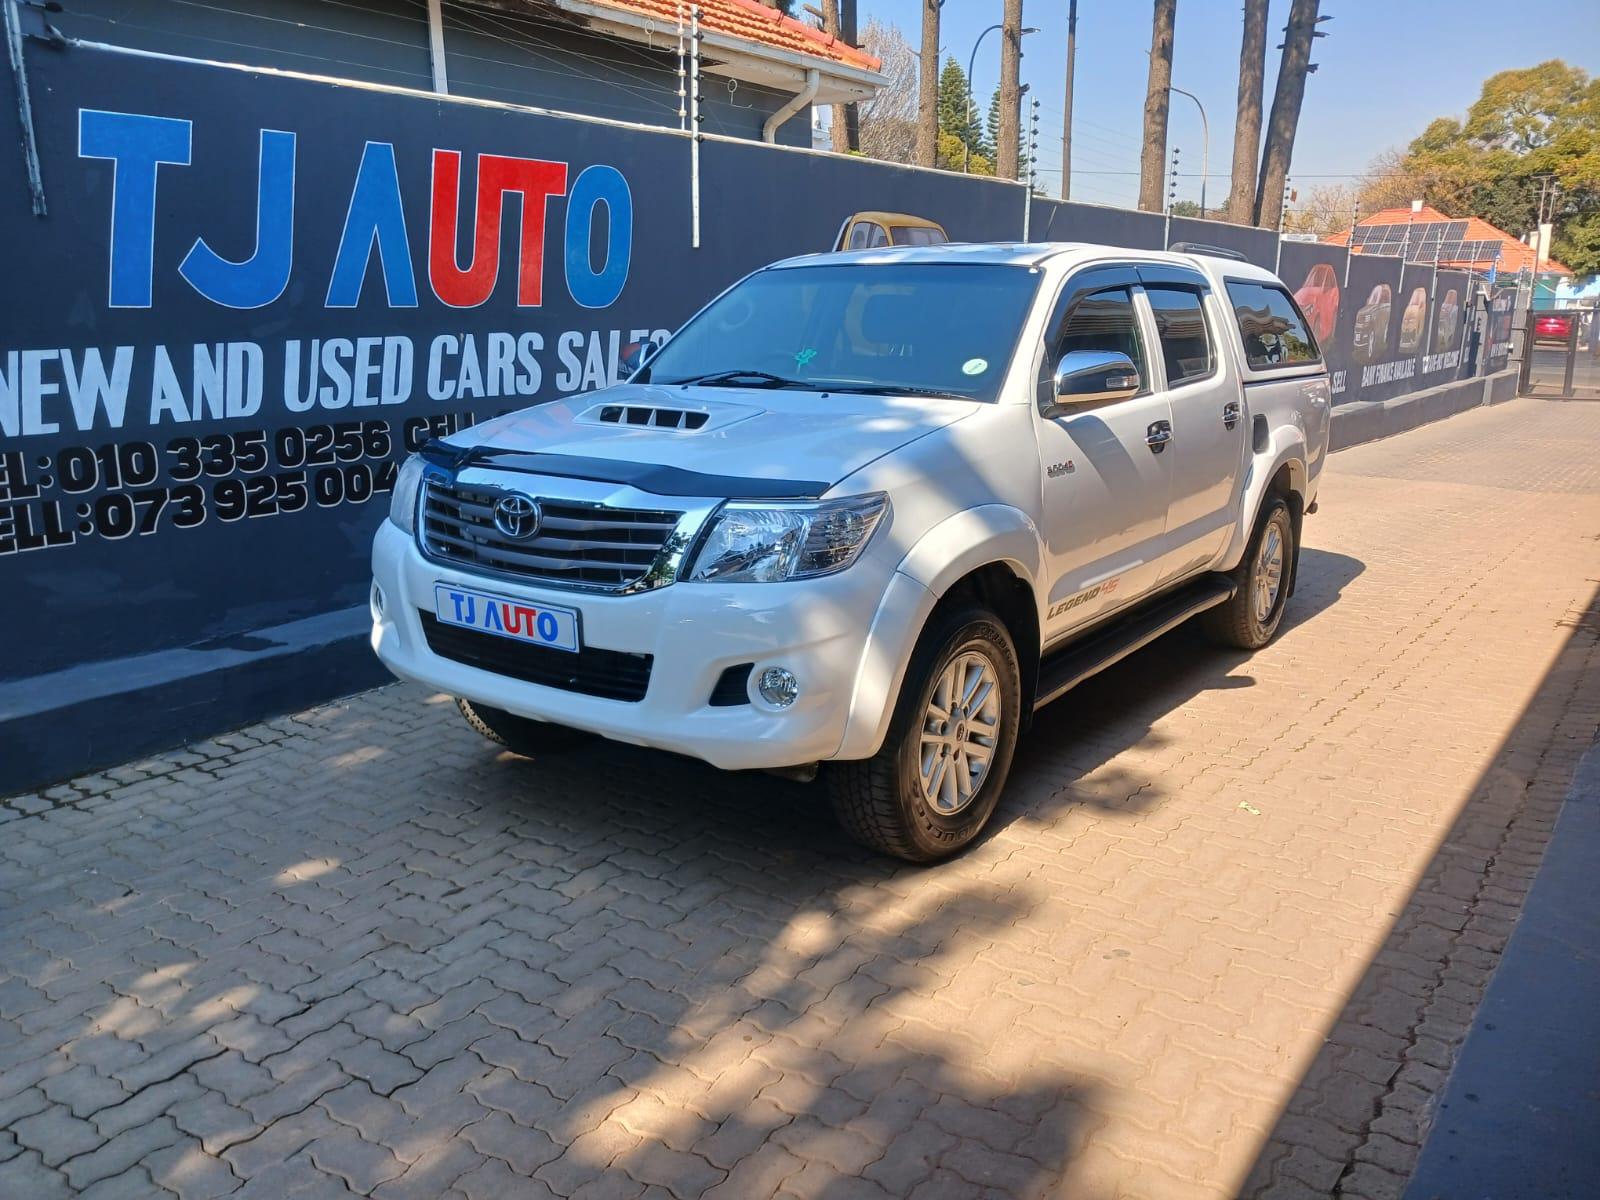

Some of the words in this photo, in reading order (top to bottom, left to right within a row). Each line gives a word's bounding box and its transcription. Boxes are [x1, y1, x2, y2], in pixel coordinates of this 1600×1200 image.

[78, 108, 297, 309] TJ
[325, 140, 633, 309] AUTO
[0, 346, 135, 437] NEW
[150, 341, 264, 425] AND
[283, 335, 413, 412] USED
[427, 332, 545, 401] CARS
[556, 329, 672, 392] SAL
[166, 430, 269, 483] 335
[275, 421, 392, 469] 0256
[213, 470, 309, 522] 925
[451, 593, 475, 624] TJ
[485, 601, 558, 641] AUTO
